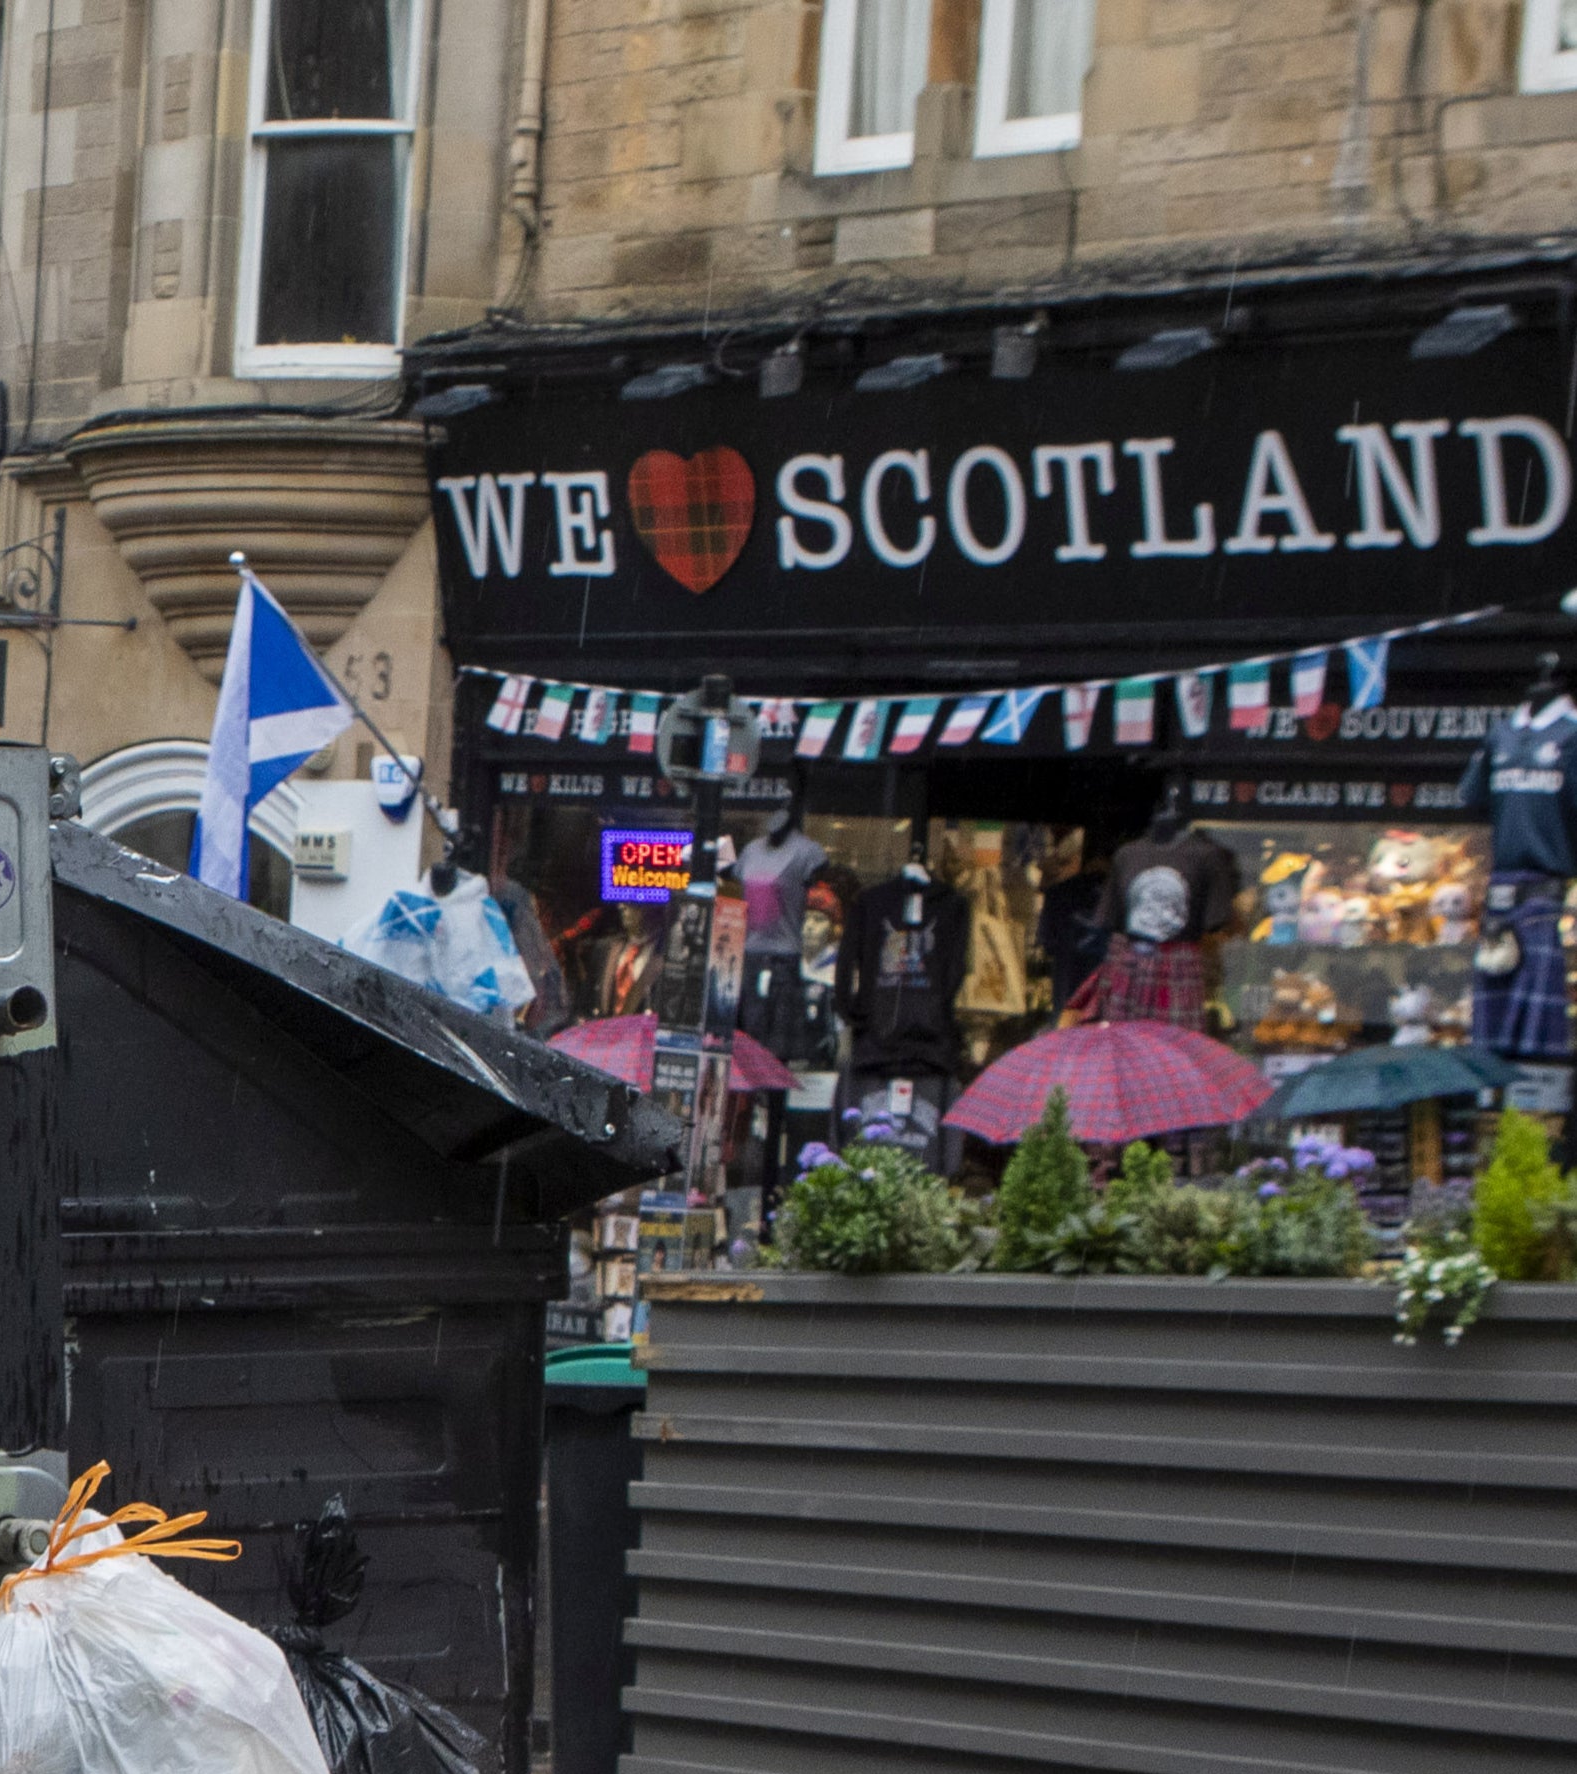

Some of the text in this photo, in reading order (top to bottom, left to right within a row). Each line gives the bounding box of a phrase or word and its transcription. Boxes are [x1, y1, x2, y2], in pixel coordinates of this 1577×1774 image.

[436, 414, 1573, 579] WE SCOTLAND
[500, 773, 528, 793] WE
[548, 774, 604, 795] KILTS
[1191, 779, 1231, 806] WE
[1256, 781, 1341, 807] CLANS
[1345, 781, 1387, 807] WE
[620, 842, 683, 866] OPEN
